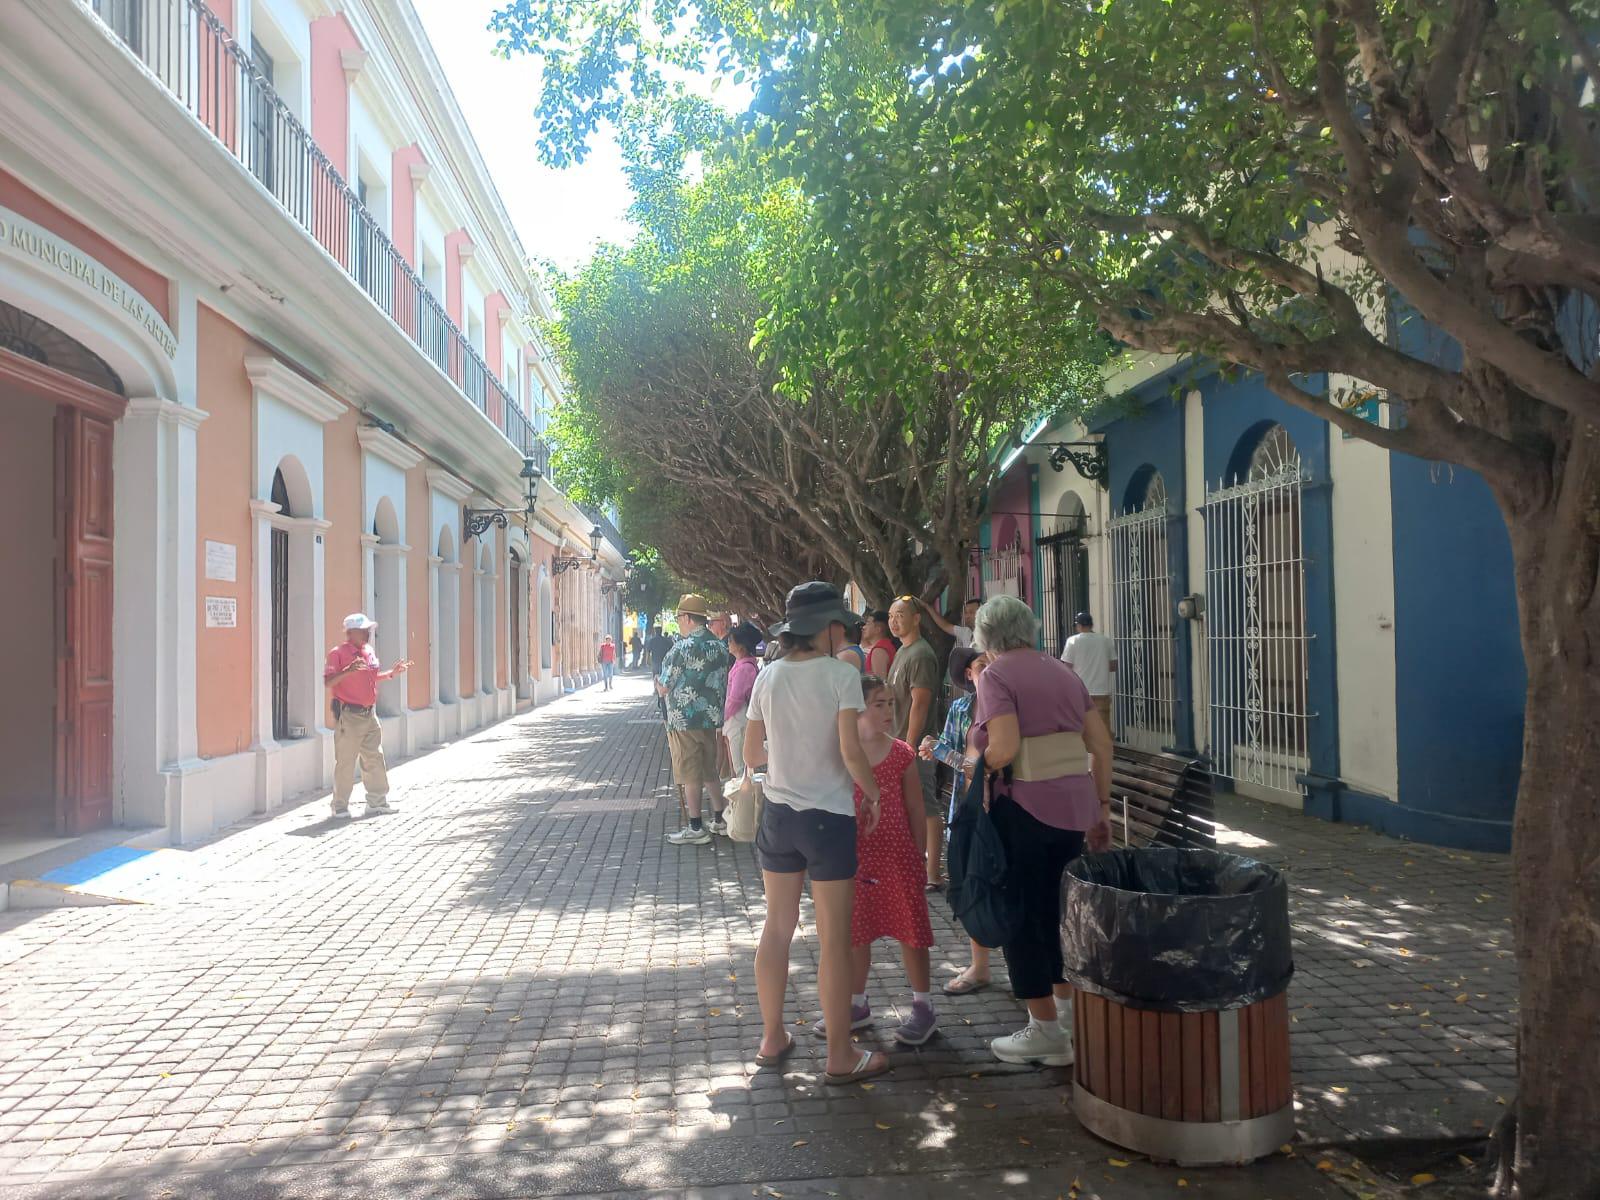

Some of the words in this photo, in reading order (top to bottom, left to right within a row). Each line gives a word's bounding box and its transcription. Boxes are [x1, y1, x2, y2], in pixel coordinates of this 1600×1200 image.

[11, 225, 98, 290] MUNICIPAL
[101, 275, 121, 303] DE
[122, 290, 144, 321] LAS
[143, 314, 177, 359] ARTES
